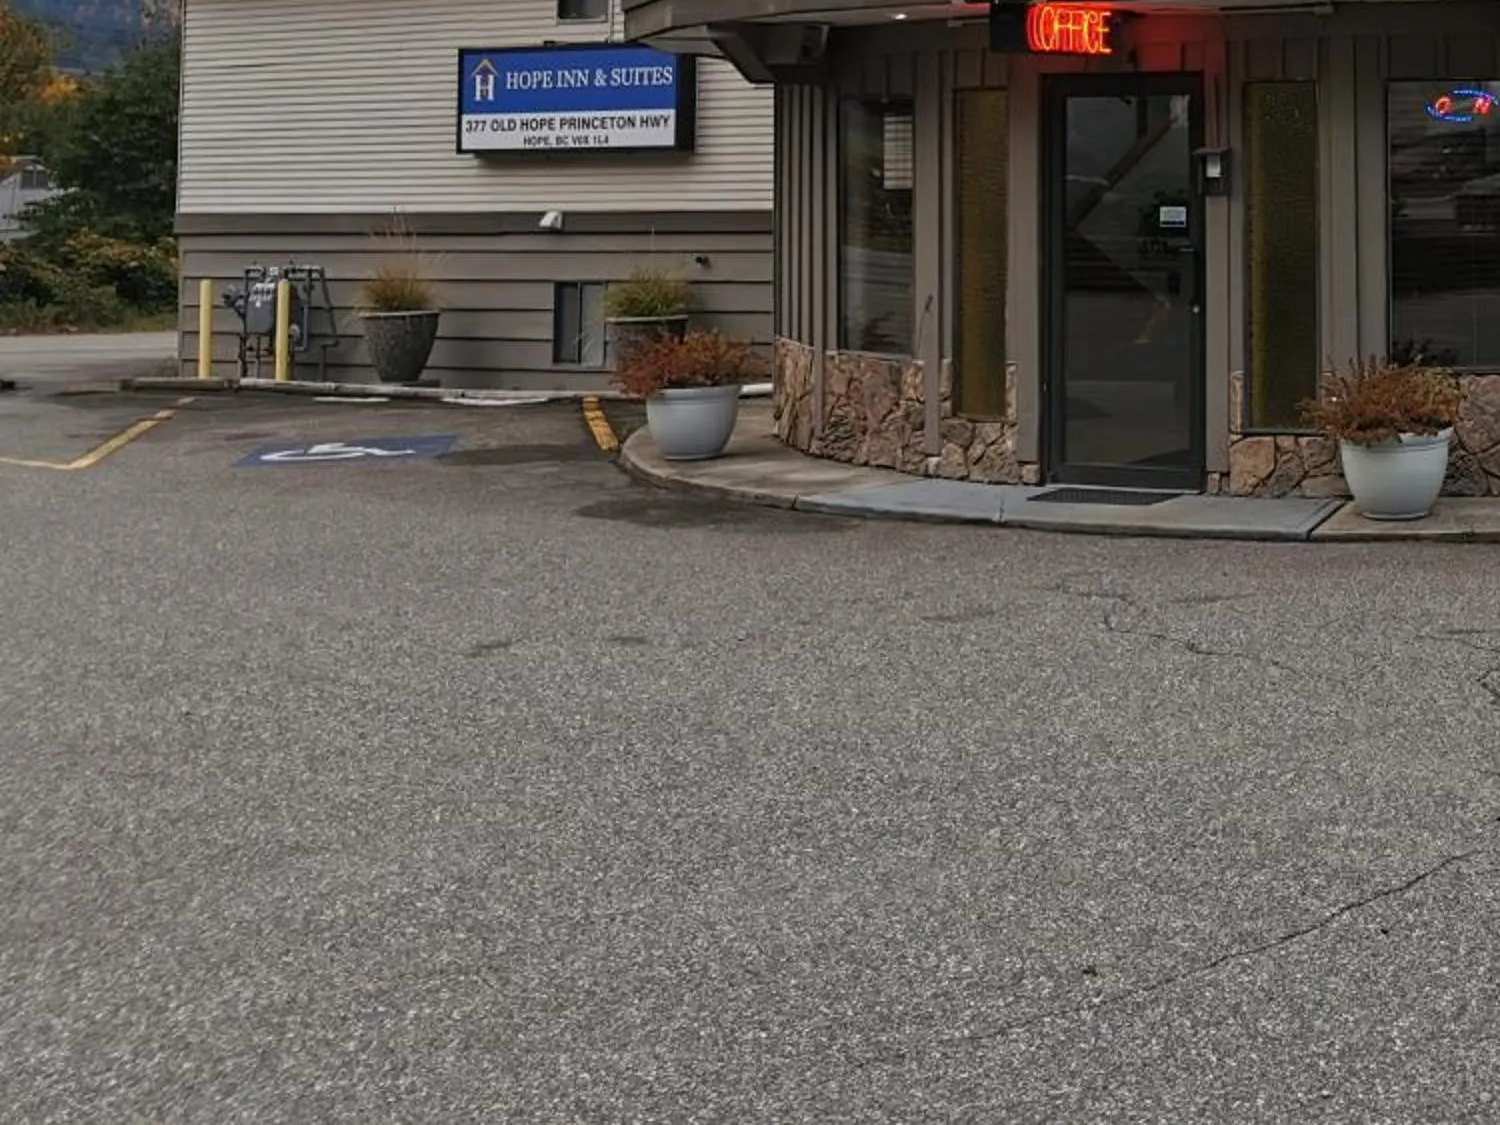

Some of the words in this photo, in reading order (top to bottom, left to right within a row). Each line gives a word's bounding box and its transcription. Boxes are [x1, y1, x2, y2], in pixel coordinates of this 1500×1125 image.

[1037, 6, 1113, 54] OFFICE
[506, 70, 552, 90] HOPE
[556, 69, 589, 88] INN
[593, 68, 609, 87] &
[610, 66, 674, 87] SUITES
[465, 119, 486, 133] 377
[491, 118, 517, 132] OLD
[519, 116, 556, 132] HOPE
[559, 115, 637, 131] PRINCETON
[639, 114, 671, 128] HWY
